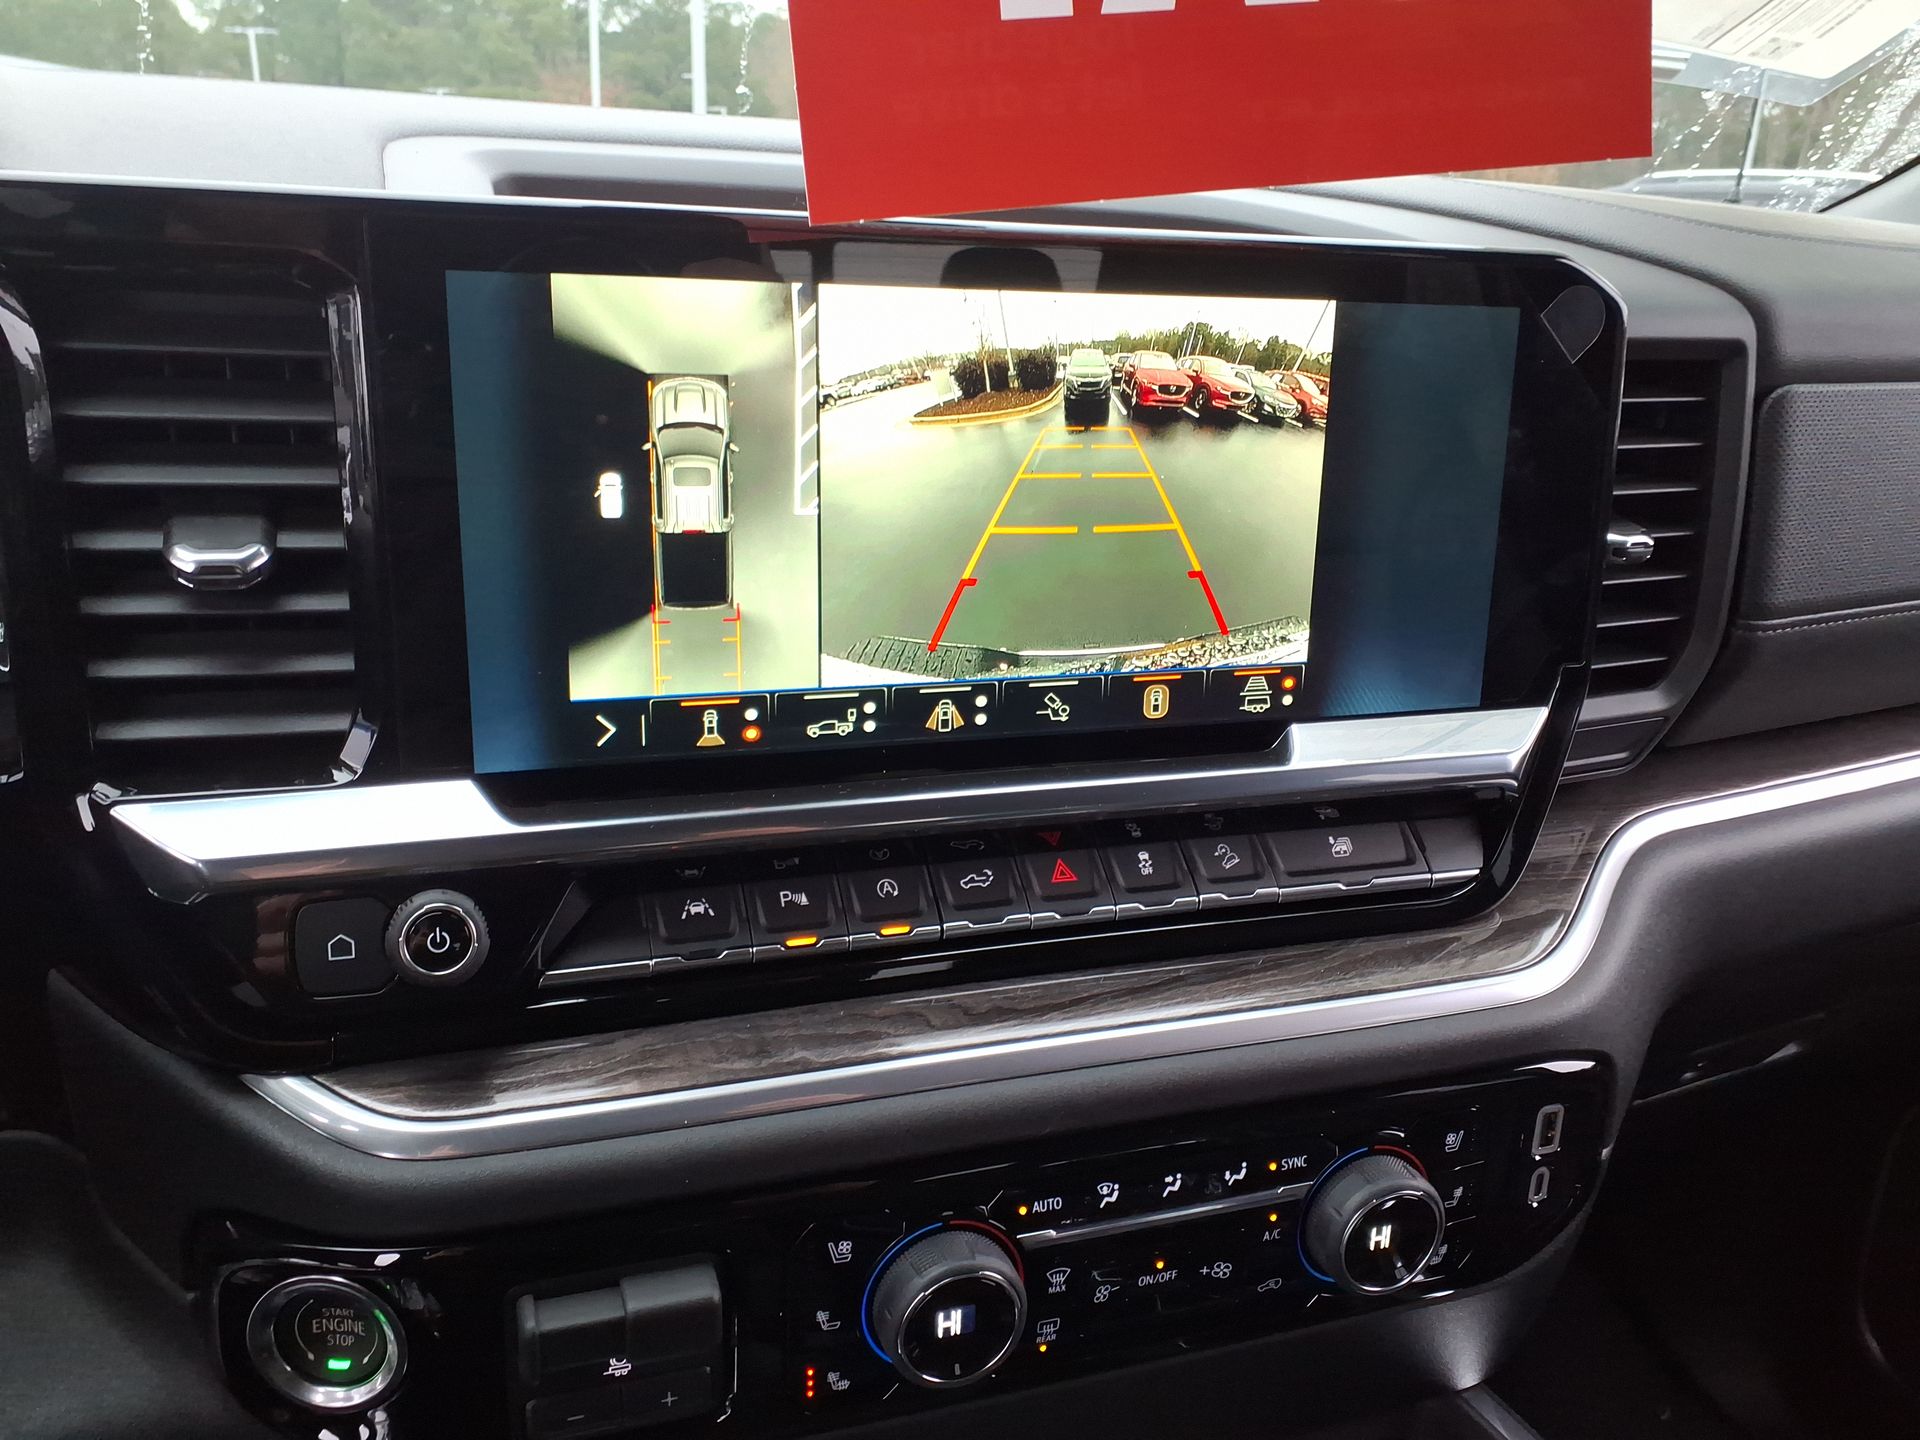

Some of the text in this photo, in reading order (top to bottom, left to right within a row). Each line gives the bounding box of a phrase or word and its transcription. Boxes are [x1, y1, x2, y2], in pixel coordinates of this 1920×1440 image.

[1140, 866, 1154, 876] OFF
[1280, 1154, 1308, 1172] SYNC
[1032, 1196, 1063, 1214] AUTO
[1262, 1228, 1281, 1242] A/C
[1368, 1224, 1392, 1252] HI
[1138, 1269, 1179, 1287] ON/OFF
[1047, 1284, 1067, 1294] MAX
[322, 1307, 355, 1318] START
[312, 1317, 367, 1338] ENGINE
[937, 1309, 962, 1339] HI
[327, 1333, 355, 1347] STOP
[1036, 1333, 1057, 1344] REAR
